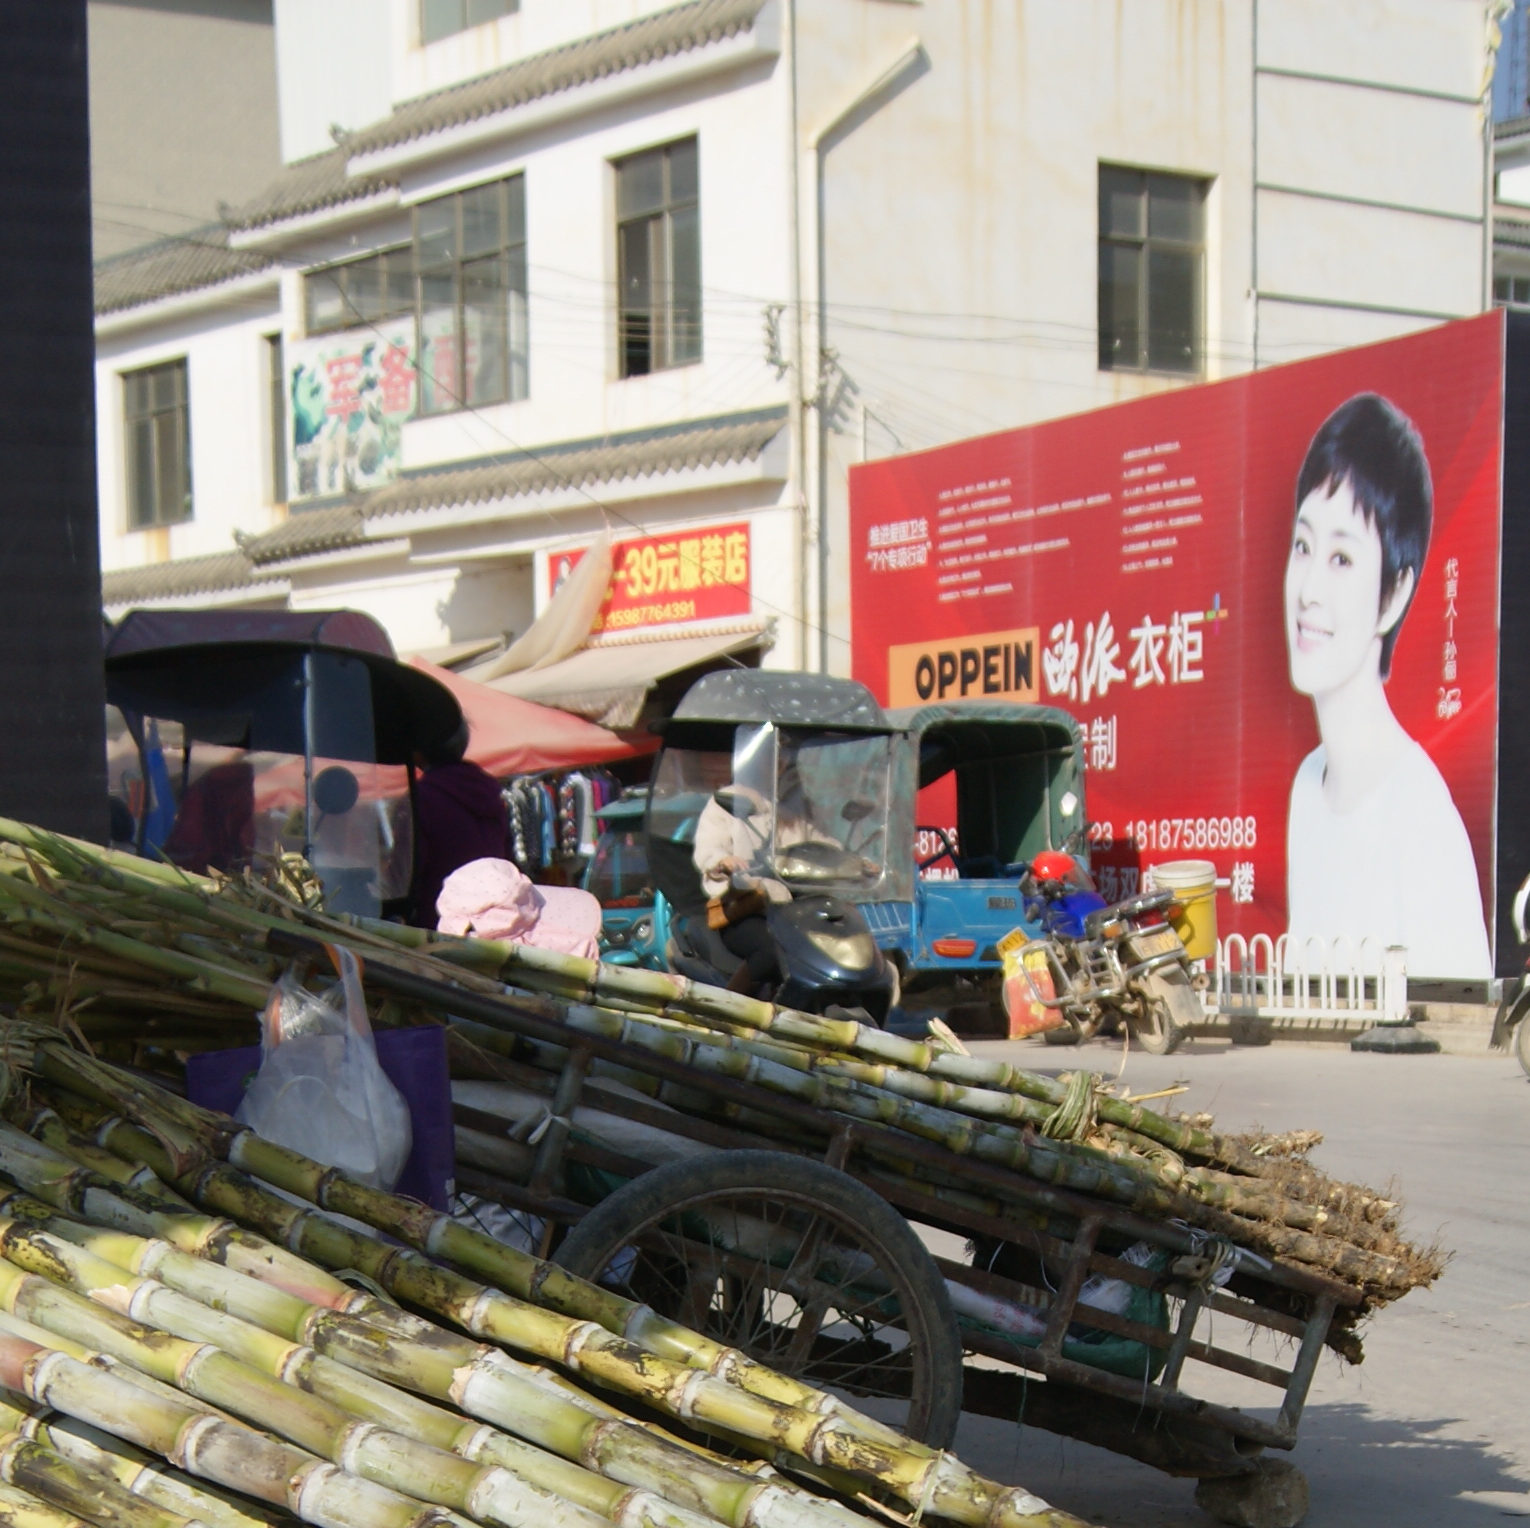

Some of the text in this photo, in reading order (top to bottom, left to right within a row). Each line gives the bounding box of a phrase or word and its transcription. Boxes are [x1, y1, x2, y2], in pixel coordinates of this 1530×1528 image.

[604, 532, 748, 600] -39元服装店
[915, 640, 1033, 700] OPPEIN
[1125, 815, 1256, 850] 18187586988
